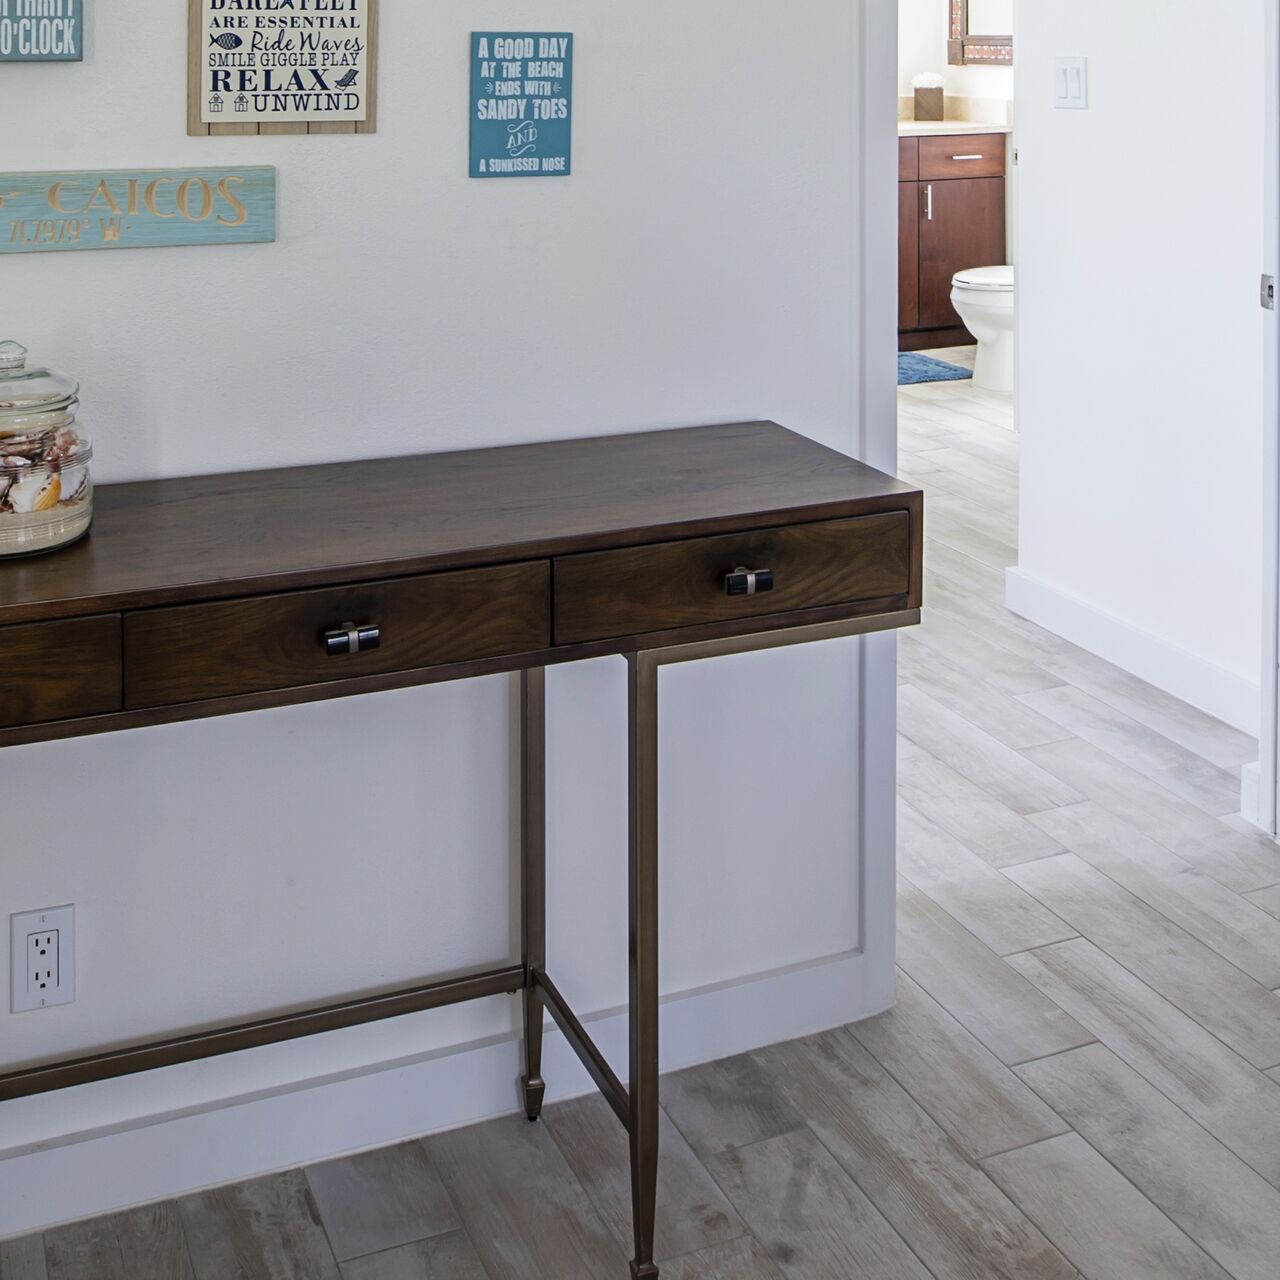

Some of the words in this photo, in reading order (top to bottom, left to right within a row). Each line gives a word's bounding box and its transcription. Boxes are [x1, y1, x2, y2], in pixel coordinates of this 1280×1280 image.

[209, 16, 248, 28] ARE
[255, 16, 360, 28] ESSENTIAL
[0, 19, 75, 54] O'CLOCK
[251, 29, 295, 52] Ride
[300, 31, 364, 51] Waves
[478, 38, 488, 58] A
[494, 38, 534, 59] GOOD
[539, 38, 568, 58] DAY
[209, 53, 255, 67] SMILE
[260, 53, 317, 66] GIGGLE
[321, 53, 359, 66] PLAY
[481, 62, 496, 78] AT
[502, 62, 521, 78] THE
[528, 62, 563, 78] BEACH
[209, 69, 331, 92] RELAX
[495, 81, 521, 95] ENDS
[524, 81, 551, 95] WITH
[252, 93, 359, 111] UNWIND
[478, 98, 527, 120] SANDY
[532, 98, 567, 120] TOES
[506, 127, 537, 149] AND
[479, 159, 486, 172] A
[489, 158, 539, 172] SUNKISSED
[543, 157, 565, 170] NOSE
[48, 176, 247, 227] CAICOS
